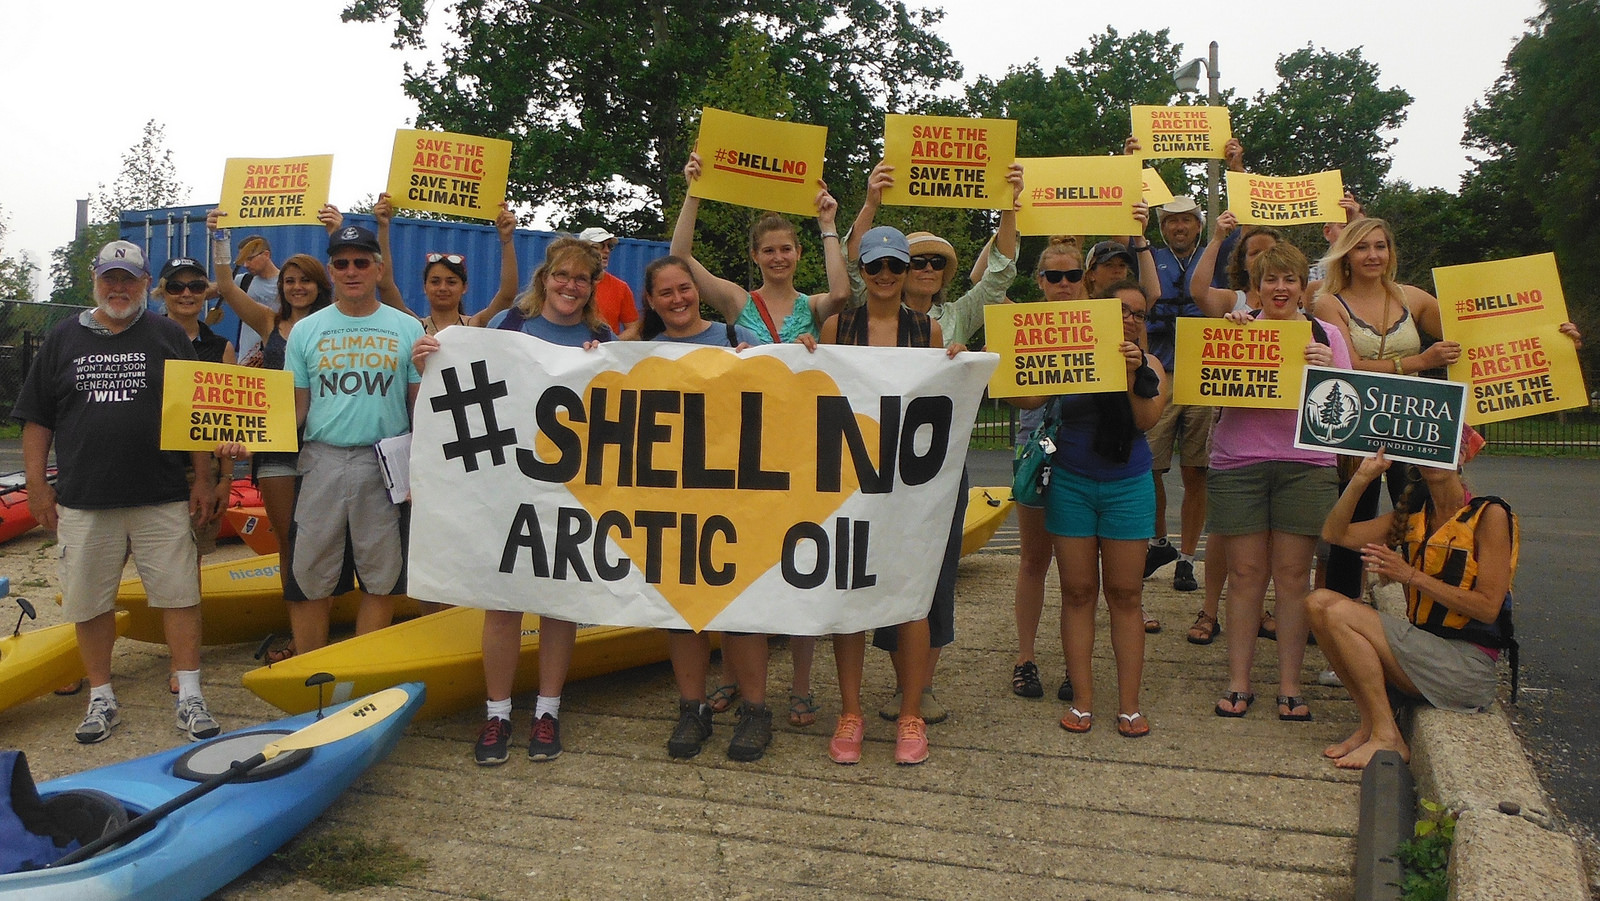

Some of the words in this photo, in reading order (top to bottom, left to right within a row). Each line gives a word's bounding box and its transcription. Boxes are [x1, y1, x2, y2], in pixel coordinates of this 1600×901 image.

[913, 126, 952, 139] SAVE
[957, 128, 987, 141] THE
[1153, 134, 1182, 142] SAVE
[416, 139, 452, 152] SAVE
[457, 143, 484, 157] THE
[912, 141, 990, 161] ARCTIC,
[1153, 143, 1213, 152] CLIMATE.
[247, 165, 280, 175] SAVE
[284, 163, 309, 173] THE
[414, 152, 486, 176] ARCTIC,
[714, 148, 807, 176] #SHELLNO
[244, 174, 310, 188] ARCTIC,
[910, 167, 949, 180] SAVE
[955, 169, 985, 182] THE
[411, 175, 447, 189] SAVE
[452, 179, 480, 194] THE
[909, 182, 988, 198] CLIMATE.
[1249, 180, 1283, 189] SAVE
[1287, 180, 1314, 188] THE
[241, 196, 275, 206] SAVE
[280, 195, 304, 204] THE
[409, 188, 480, 209] CLIMATE.
[1032, 186, 1122, 200] #SHELLNO
[240, 206, 305, 218] CLIMATE.
[1251, 201, 1286, 211] SAVE
[1290, 200, 1318, 211] THE
[1252, 208, 1322, 219] CLIMATE.
[115, 248, 126, 258] N
[1456, 290, 1542, 313] #SHELLNO
[1014, 312, 1054, 327] SAVE
[1059, 310, 1091, 324] THE
[1014, 326, 1098, 346] ARCTIC,
[1203, 328, 1243, 341] SAVE
[1248, 330, 1279, 342] THE
[318, 336, 399, 352] CLIMATE
[1468, 343, 1506, 361] SAVE
[1508, 337, 1541, 353] THE
[88, 353, 146, 363] CONGRESS
[1015, 354, 1057, 369] SAVE
[1062, 353, 1095, 366] THE
[1202, 343, 1284, 363] ARCTIC,
[77, 364, 103, 372] WON'T
[123, 363, 146, 371] SOON
[318, 353, 398, 372] ACTION
[1471, 351, 1551, 378] ARCTIC,
[194, 371, 233, 386] SAVE
[237, 376, 265, 390] THE
[1016, 368, 1100, 386] CLIMATE.
[1201, 368, 1241, 381] SAVE
[1246, 370, 1278, 382] THE
[320, 371, 394, 397] NOW
[1200, 382, 1281, 398] CLIMATE.
[1474, 381, 1514, 399] SAVE
[1518, 375, 1552, 391] THE
[192, 386, 270, 409] ARCTIC,
[1364, 387, 1454, 422] SIERRA
[1477, 389, 1559, 414] CLIMATE.
[191, 412, 232, 426] SAVE
[236, 415, 266, 428] THE
[1369, 413, 1440, 442] CLUB
[190, 427, 271, 442] CLIMATE.
[816, 395, 953, 493] NO
[1367, 440, 1414, 451] FOUNDED
[1418, 447, 1438, 455] 1892
[498, 504, 737, 586] ARCTIC
[781, 517, 877, 590] OIL
